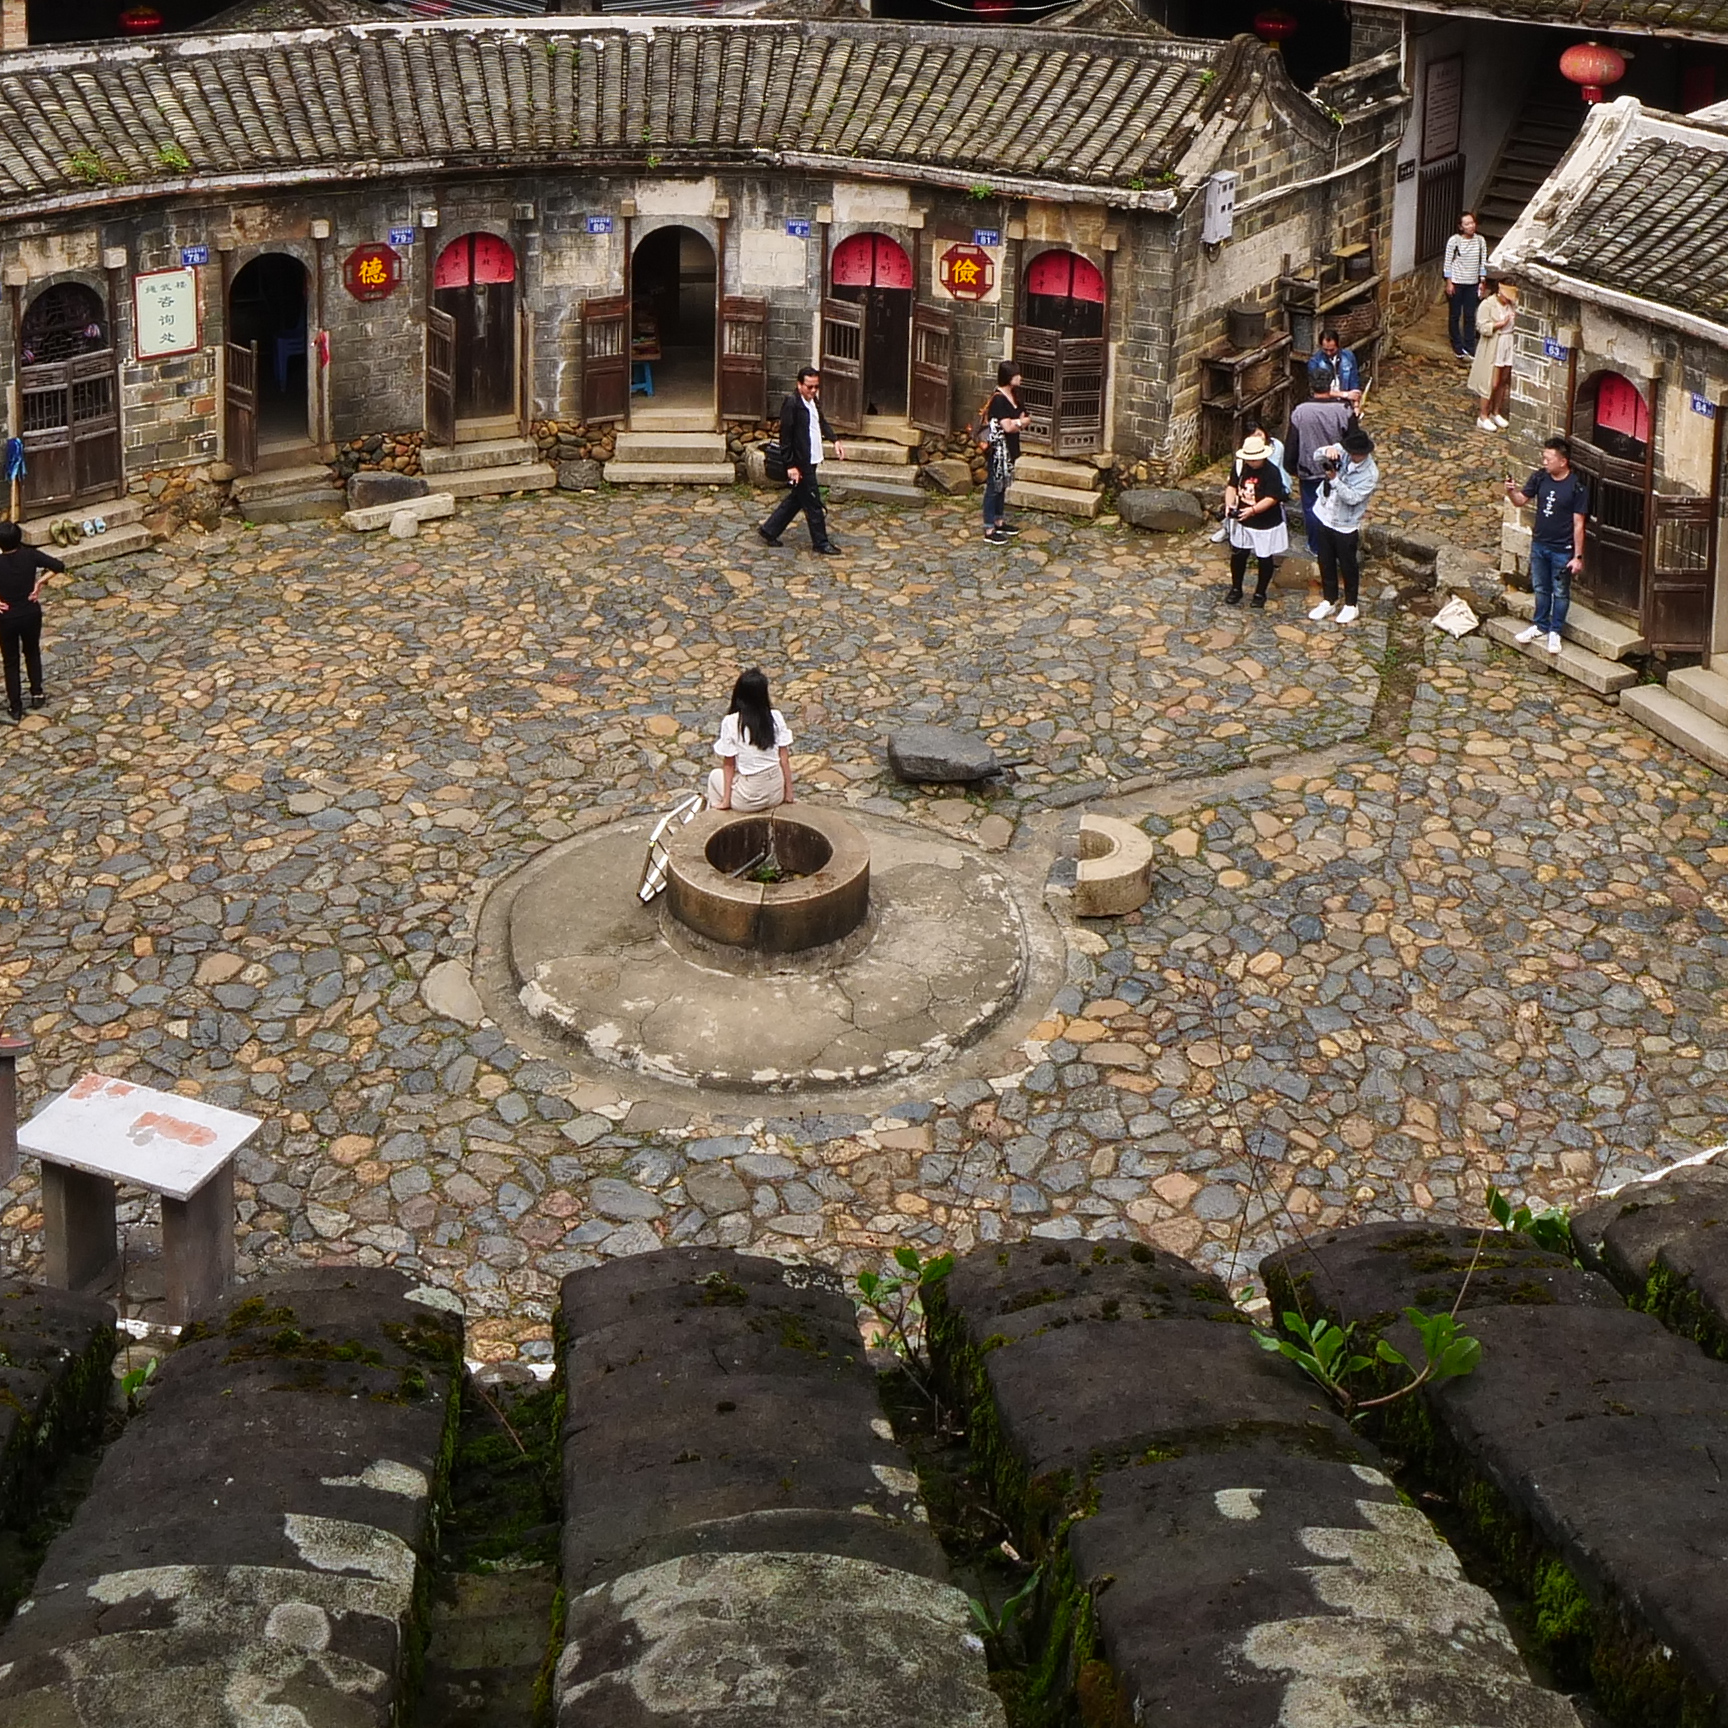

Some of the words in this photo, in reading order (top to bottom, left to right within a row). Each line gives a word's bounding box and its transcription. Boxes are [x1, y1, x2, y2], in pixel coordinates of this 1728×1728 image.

[358, 257, 387, 285] 德
[952, 258, 981, 286] 儉
[157, 295, 176, 344] 咨询处
